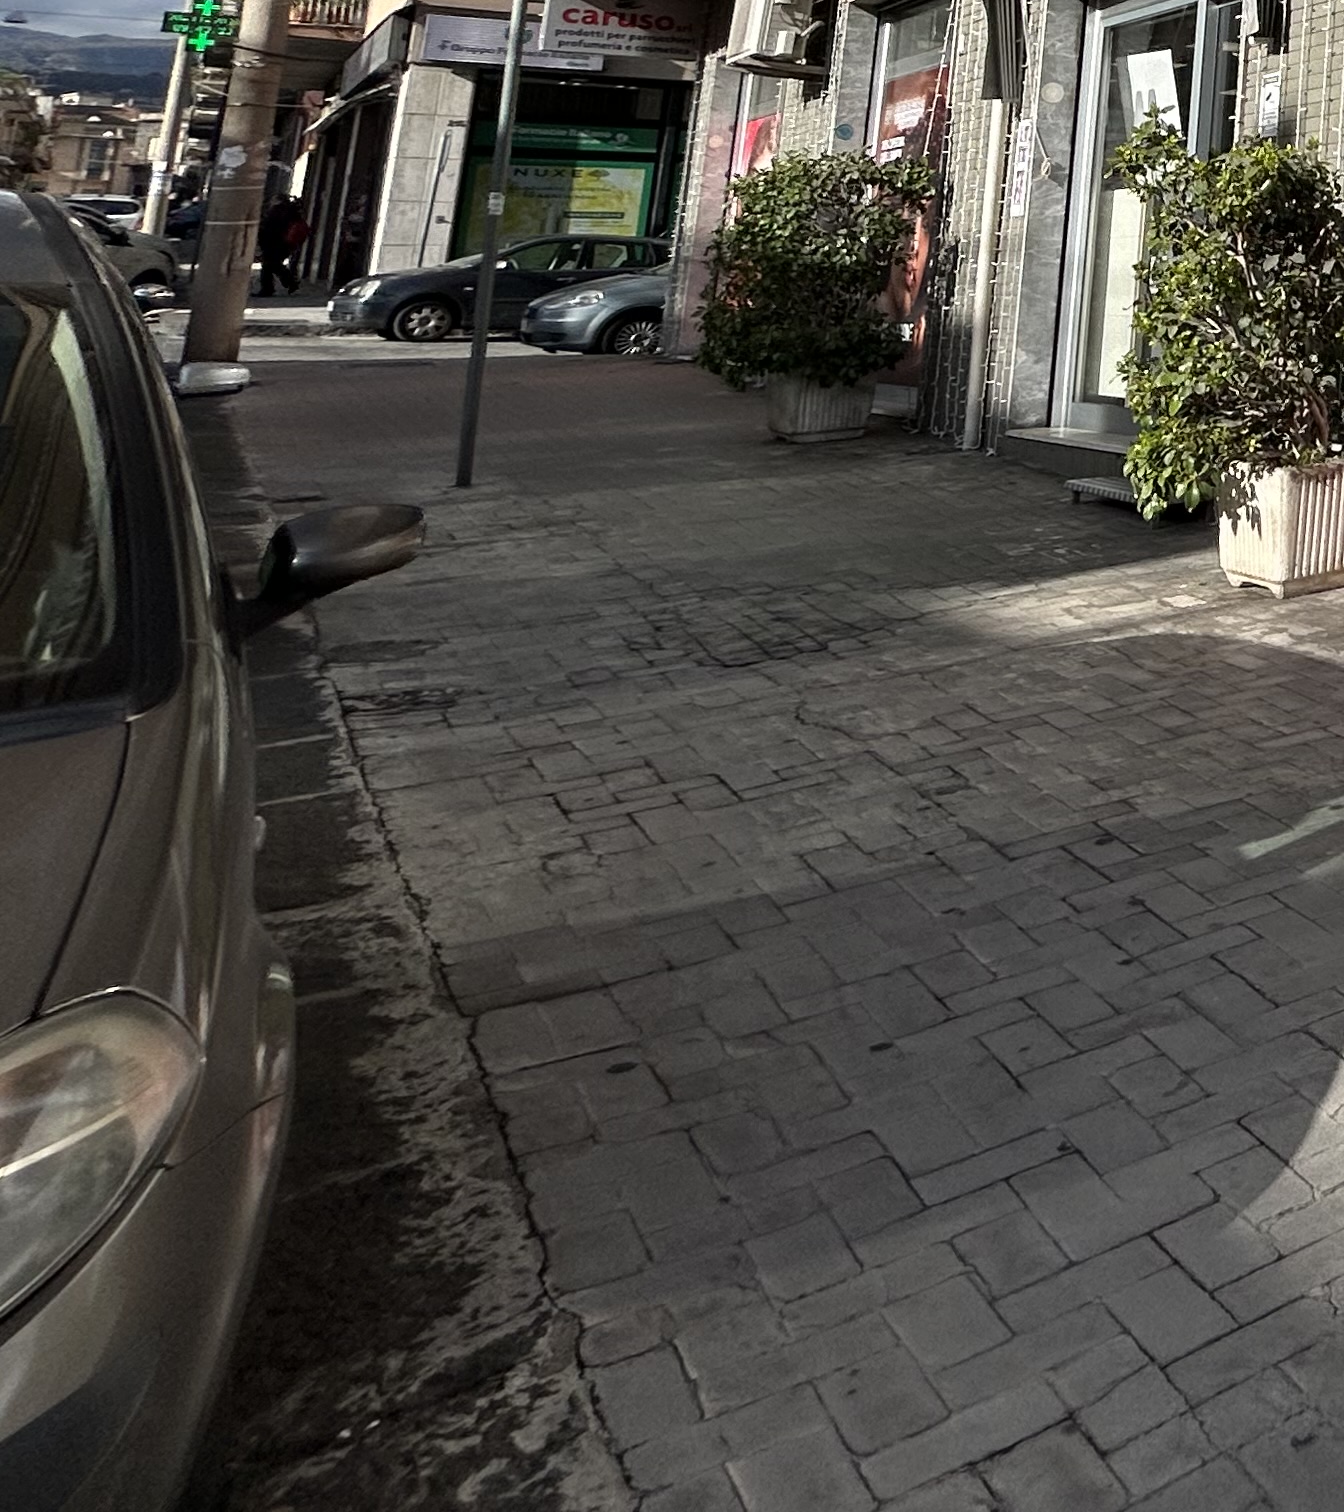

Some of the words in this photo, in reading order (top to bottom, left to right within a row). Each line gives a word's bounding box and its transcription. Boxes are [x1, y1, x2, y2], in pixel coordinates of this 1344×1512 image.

[562, 7, 675, 31] caruso
[555, 28, 605, 38] prodotti
[607, 31, 625, 40] per
[558, 39, 623, 51] profumeria
[513, 168, 584, 178] NUXE
